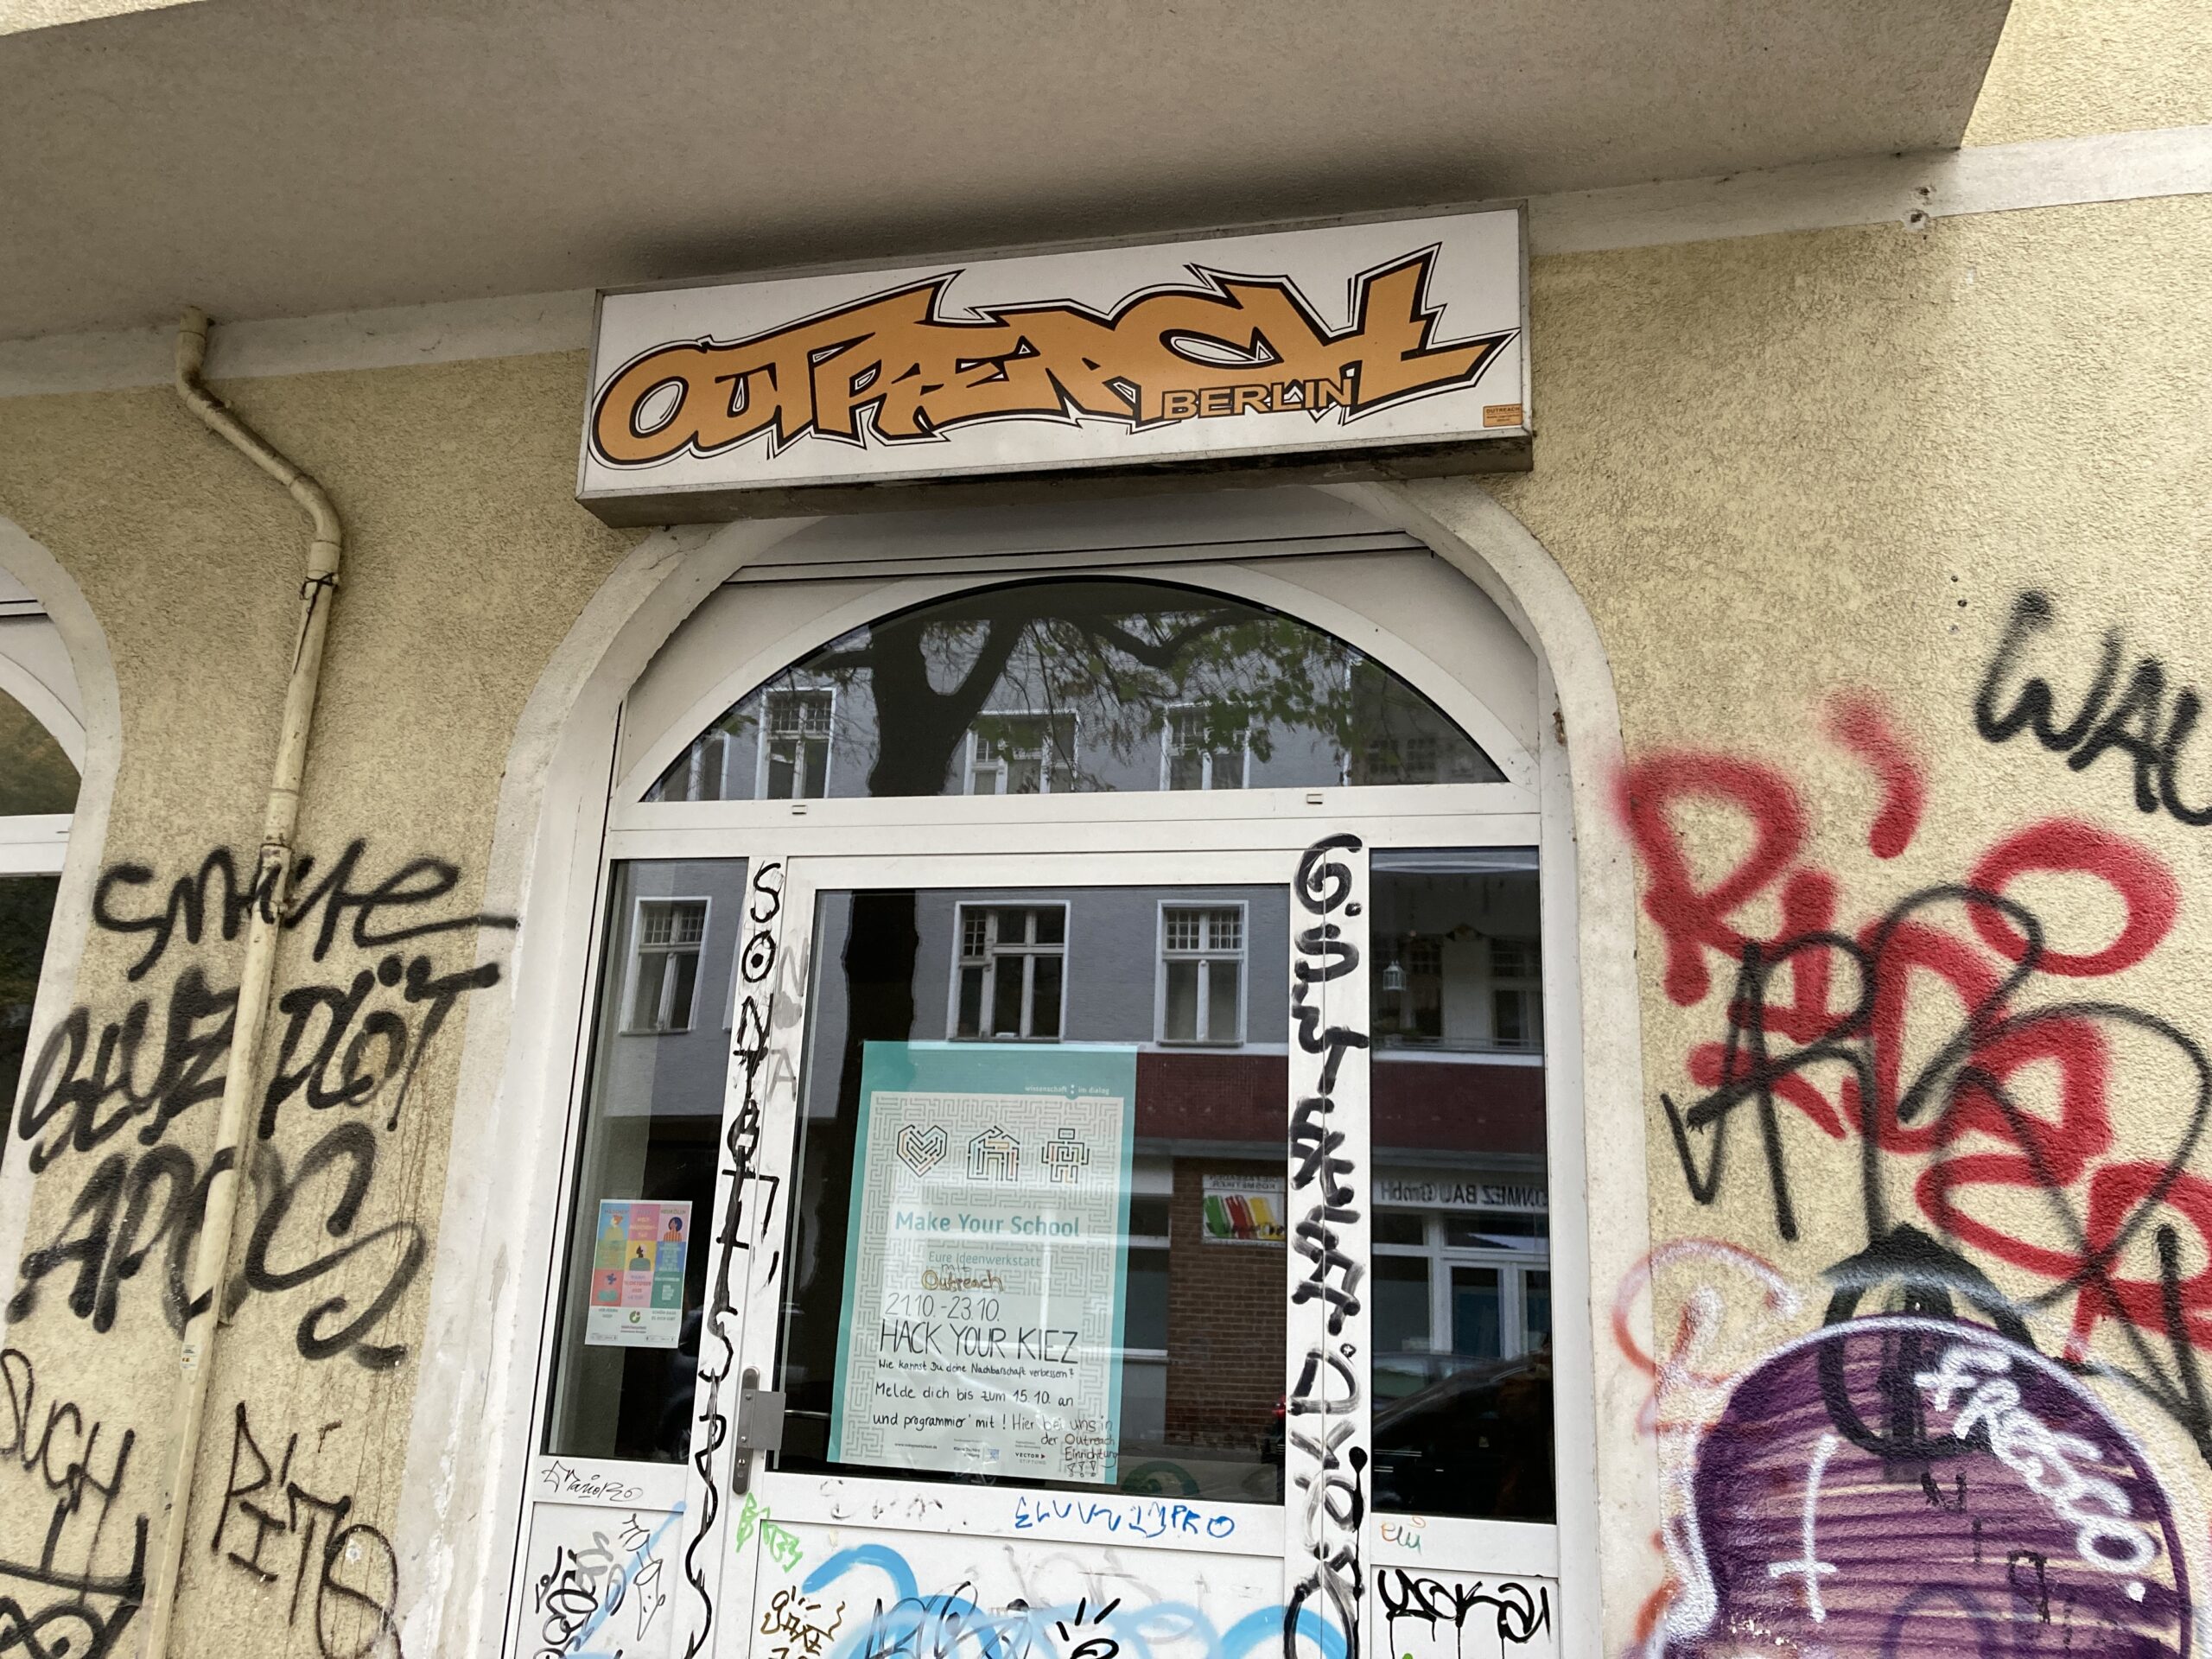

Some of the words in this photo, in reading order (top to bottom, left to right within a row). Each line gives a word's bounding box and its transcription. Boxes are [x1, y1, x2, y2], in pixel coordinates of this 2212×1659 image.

[590, 243, 1521, 465] OUTREACH
[1162, 378, 1353, 421] BERLIN
[895, 1211, 950, 1232] Make
[958, 1213, 1004, 1234] Your
[1010, 1216, 1079, 1237] School
[928, 1252, 952, 1263] Eure
[956, 1252, 1041, 1268] Ideenwerkstatt
[921, 1268, 1004, 1293] Outreach
[880, 1319, 942, 1355] HACK
[950, 1323, 1007, 1359] YOUR
[1017, 1326, 1078, 1364] KIEZ
[878, 1359, 893, 1370] Wie
[898, 1359, 927, 1371] kannst
[930, 1361, 943, 1372] Du
[971, 1363, 1026, 1378] Nachbarschaft
[874, 1382, 916, 1400] Melde
[923, 1385, 949, 1400] dich
[957, 1388, 974, 1402] bis
[981, 1389, 1006, 1402] zum
[1058, 1396, 1074, 1407] an
[873, 1409, 898, 1426] und
[976, 1416, 995, 1428] mit
[1012, 1414, 1035, 1431] Hier
[1042, 1414, 1063, 1432] bei
[1070, 1419, 1096, 1433] uns
[1041, 1432, 1058, 1446] der
[1065, 1433, 1115, 1446] Outreach
[1065, 1446, 1118, 1468] Einrichtung
